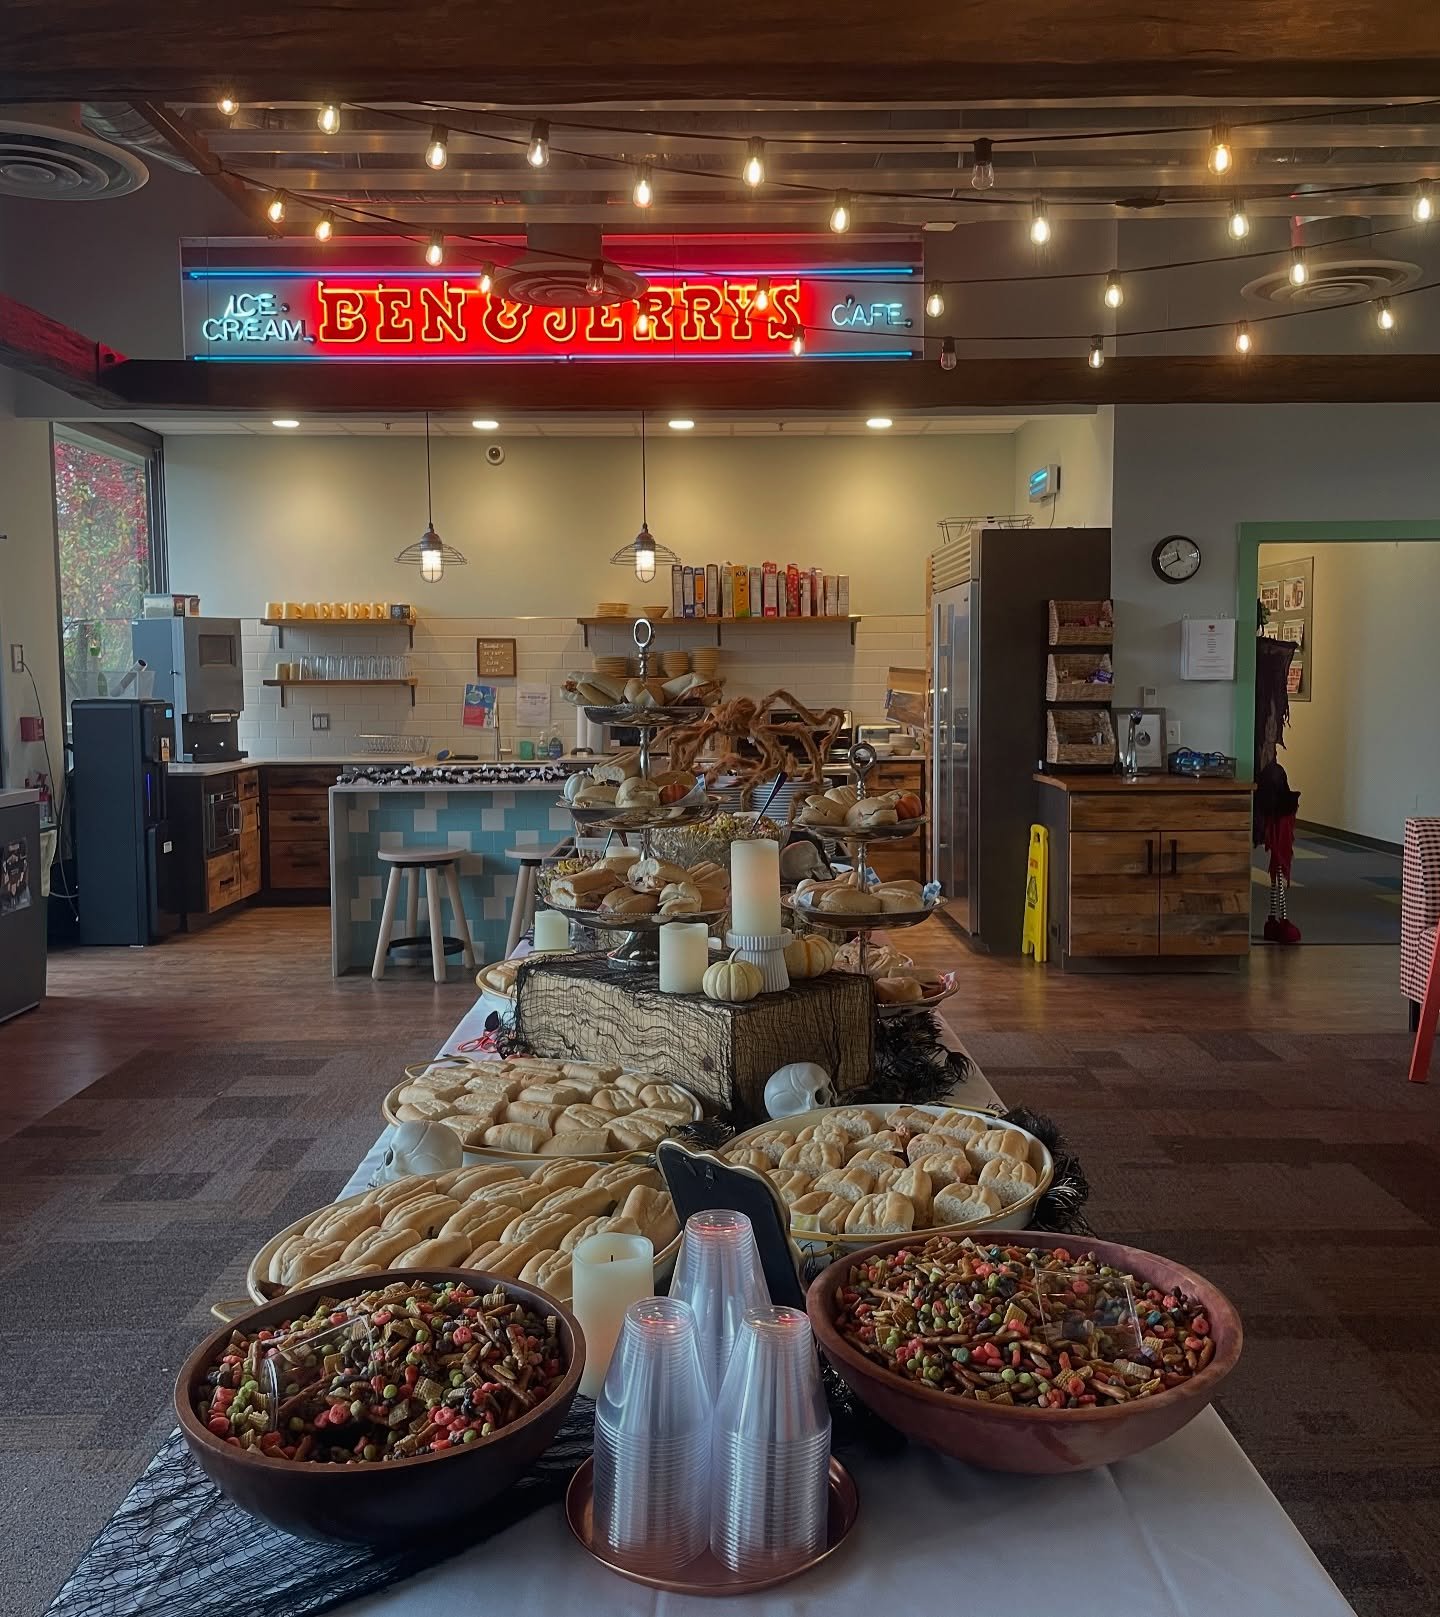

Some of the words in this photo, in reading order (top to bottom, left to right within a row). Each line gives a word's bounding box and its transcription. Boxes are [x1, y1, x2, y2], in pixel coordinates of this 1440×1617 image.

[223, 293, 277, 319] ICE
[317, 281, 467, 343] BEN
[481, 290, 534, 344] &
[831, 300, 911, 327] CAFE
[201, 317, 310, 342] CREAM
